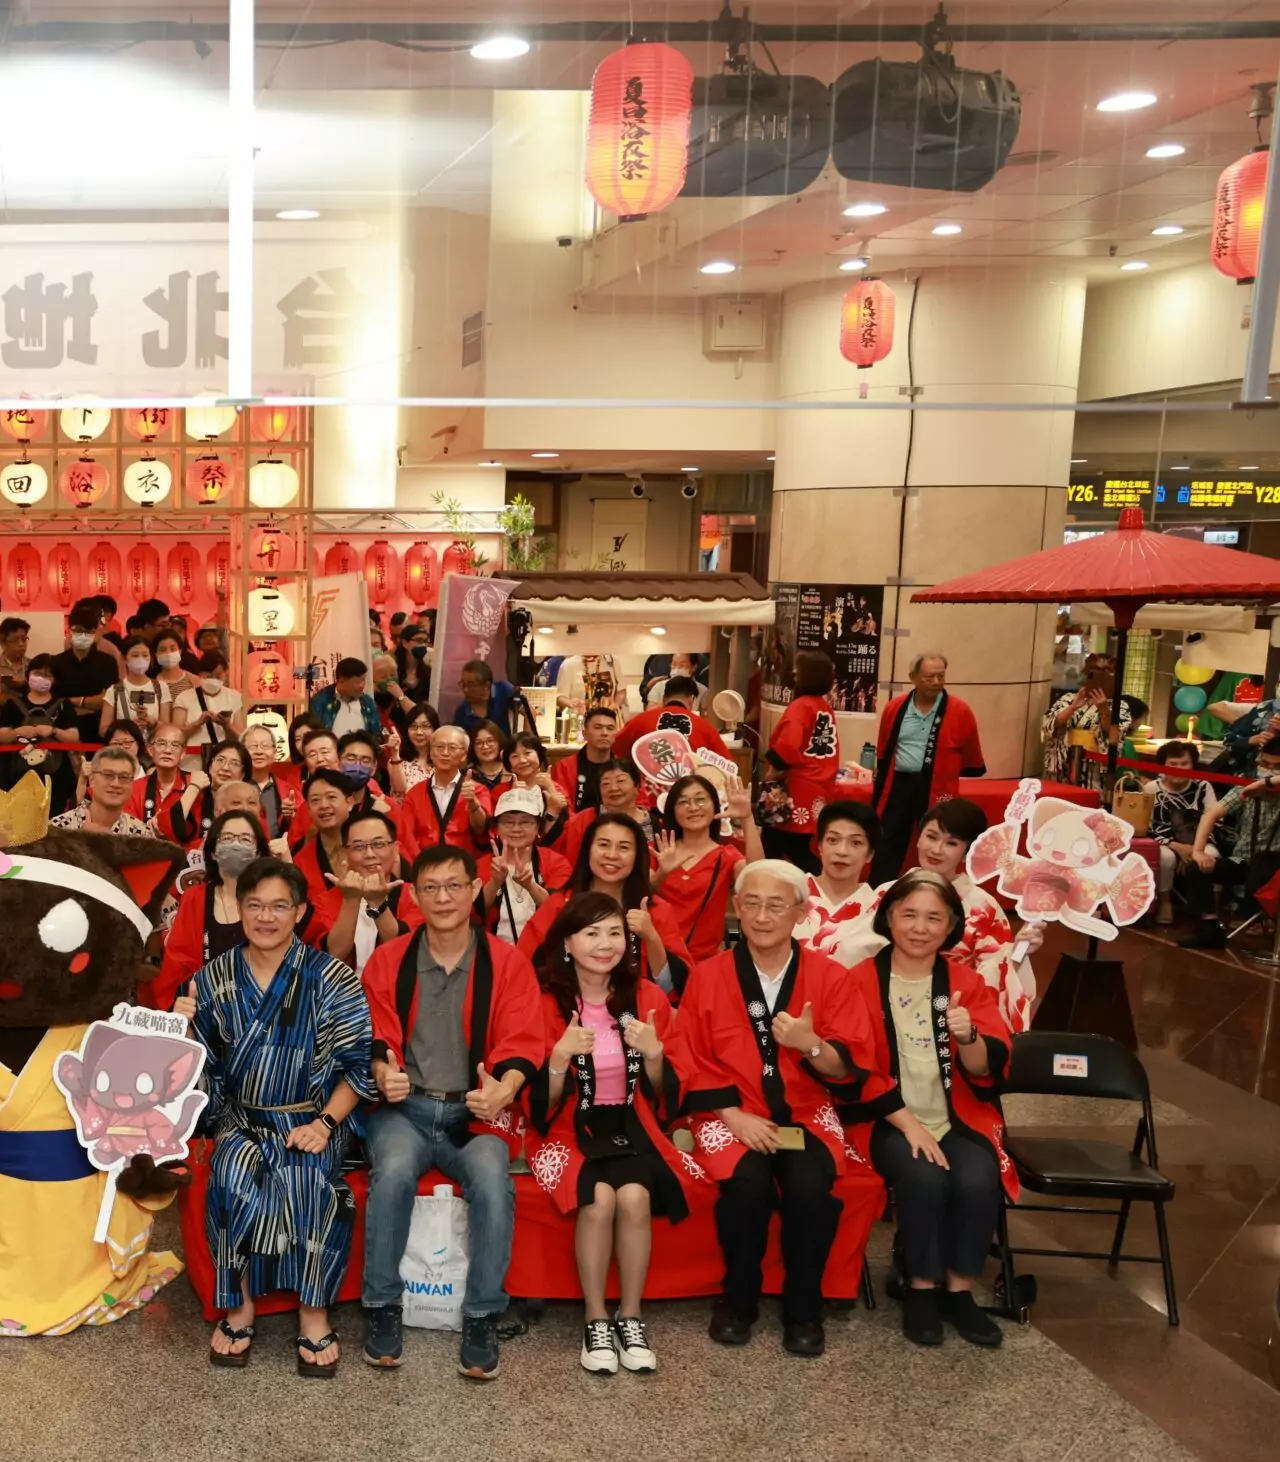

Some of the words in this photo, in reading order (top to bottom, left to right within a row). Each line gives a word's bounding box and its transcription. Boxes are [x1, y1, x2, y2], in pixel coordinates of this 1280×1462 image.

[577, 1056, 592, 1110] 日浴衣祭
[405, 1280, 453, 1297] AIWAN
